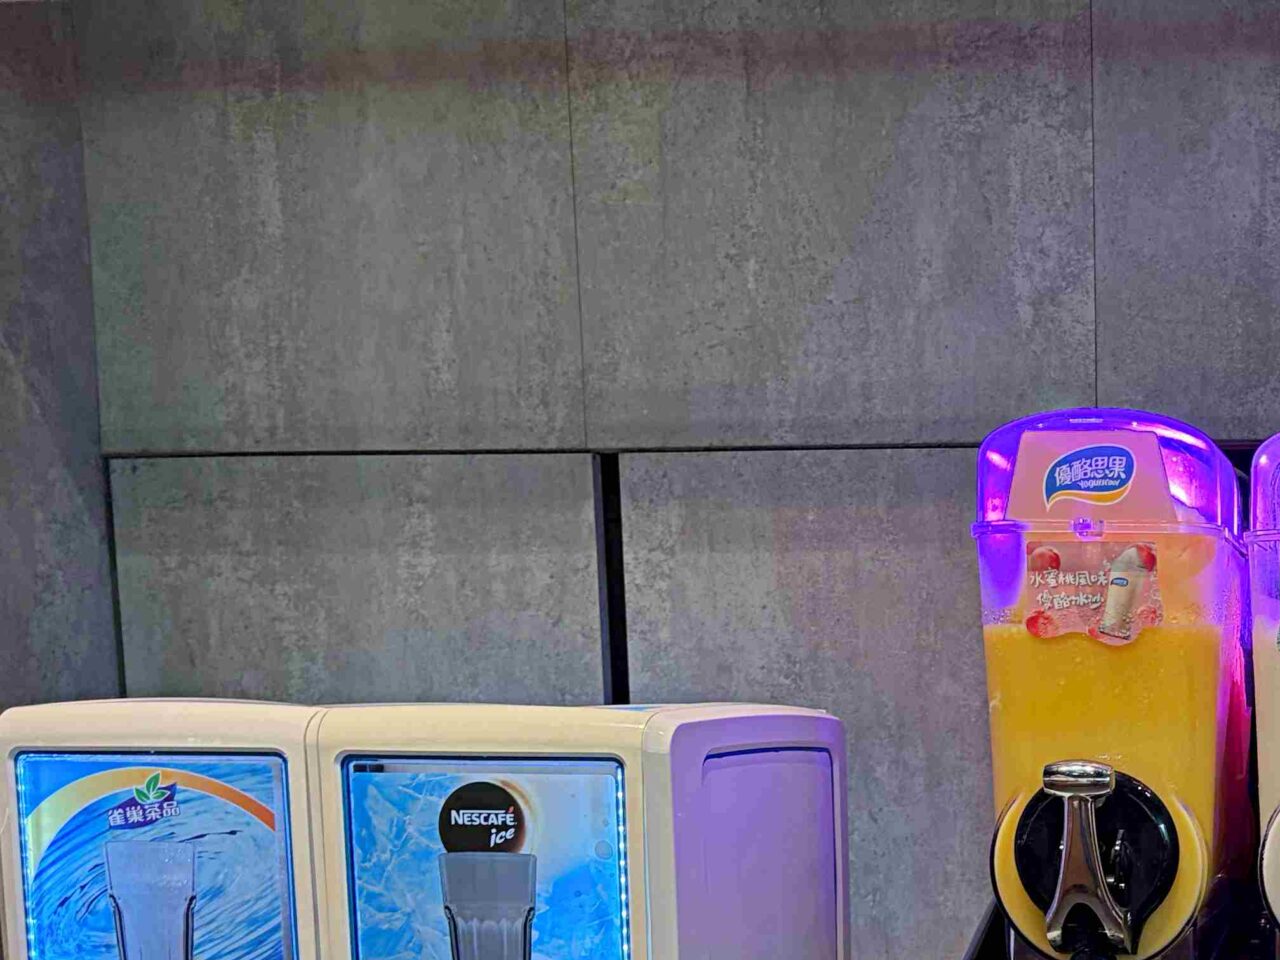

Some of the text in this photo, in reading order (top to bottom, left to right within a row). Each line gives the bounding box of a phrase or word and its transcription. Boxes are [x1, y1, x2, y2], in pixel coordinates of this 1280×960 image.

[1054, 456, 1127, 487] 優酪思果
[1030, 567, 1108, 588] 水蜜桃風味
[1037, 590, 1104, 610] 優酪冰沙
[108, 801, 181, 826] 雀巢茶品
[490, 828, 515, 848] ice
